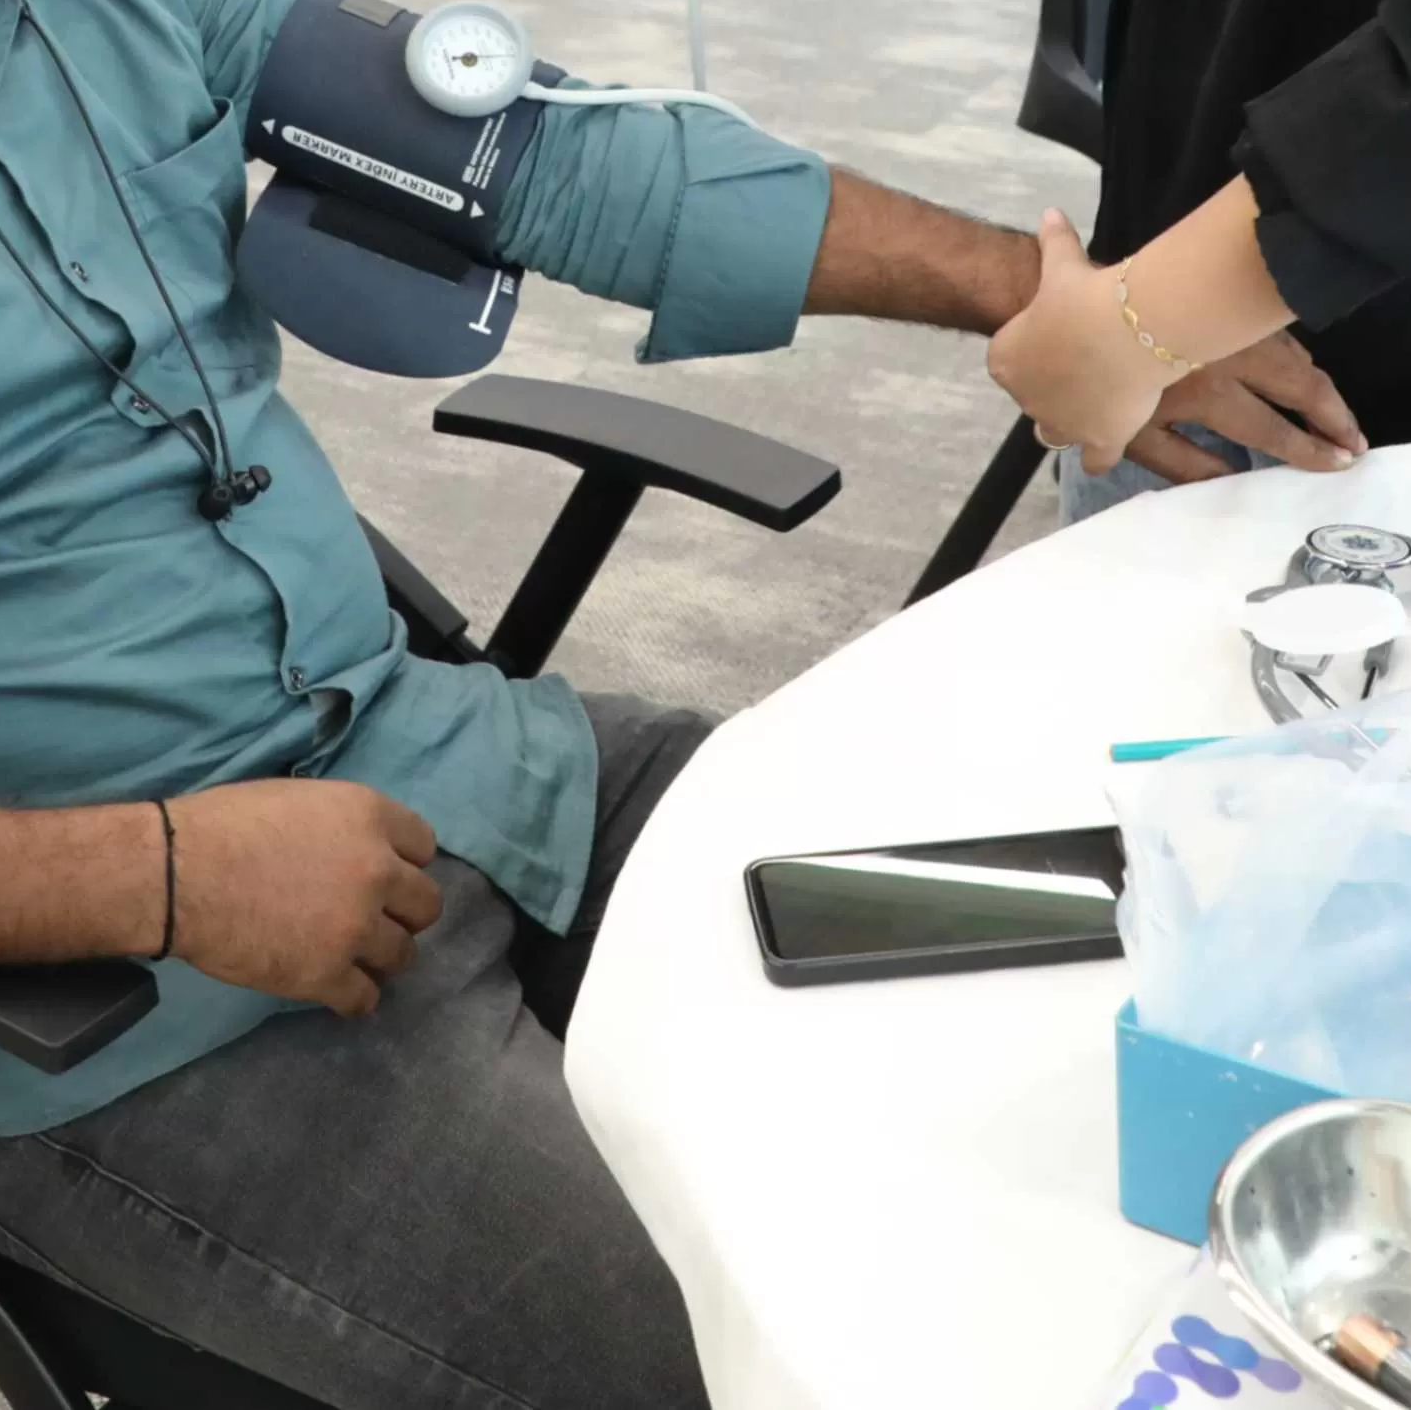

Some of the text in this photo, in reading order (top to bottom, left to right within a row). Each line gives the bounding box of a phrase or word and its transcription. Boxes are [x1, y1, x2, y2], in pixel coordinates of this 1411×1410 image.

[292, 131, 455, 205] ARTERY INDEX MARKER
